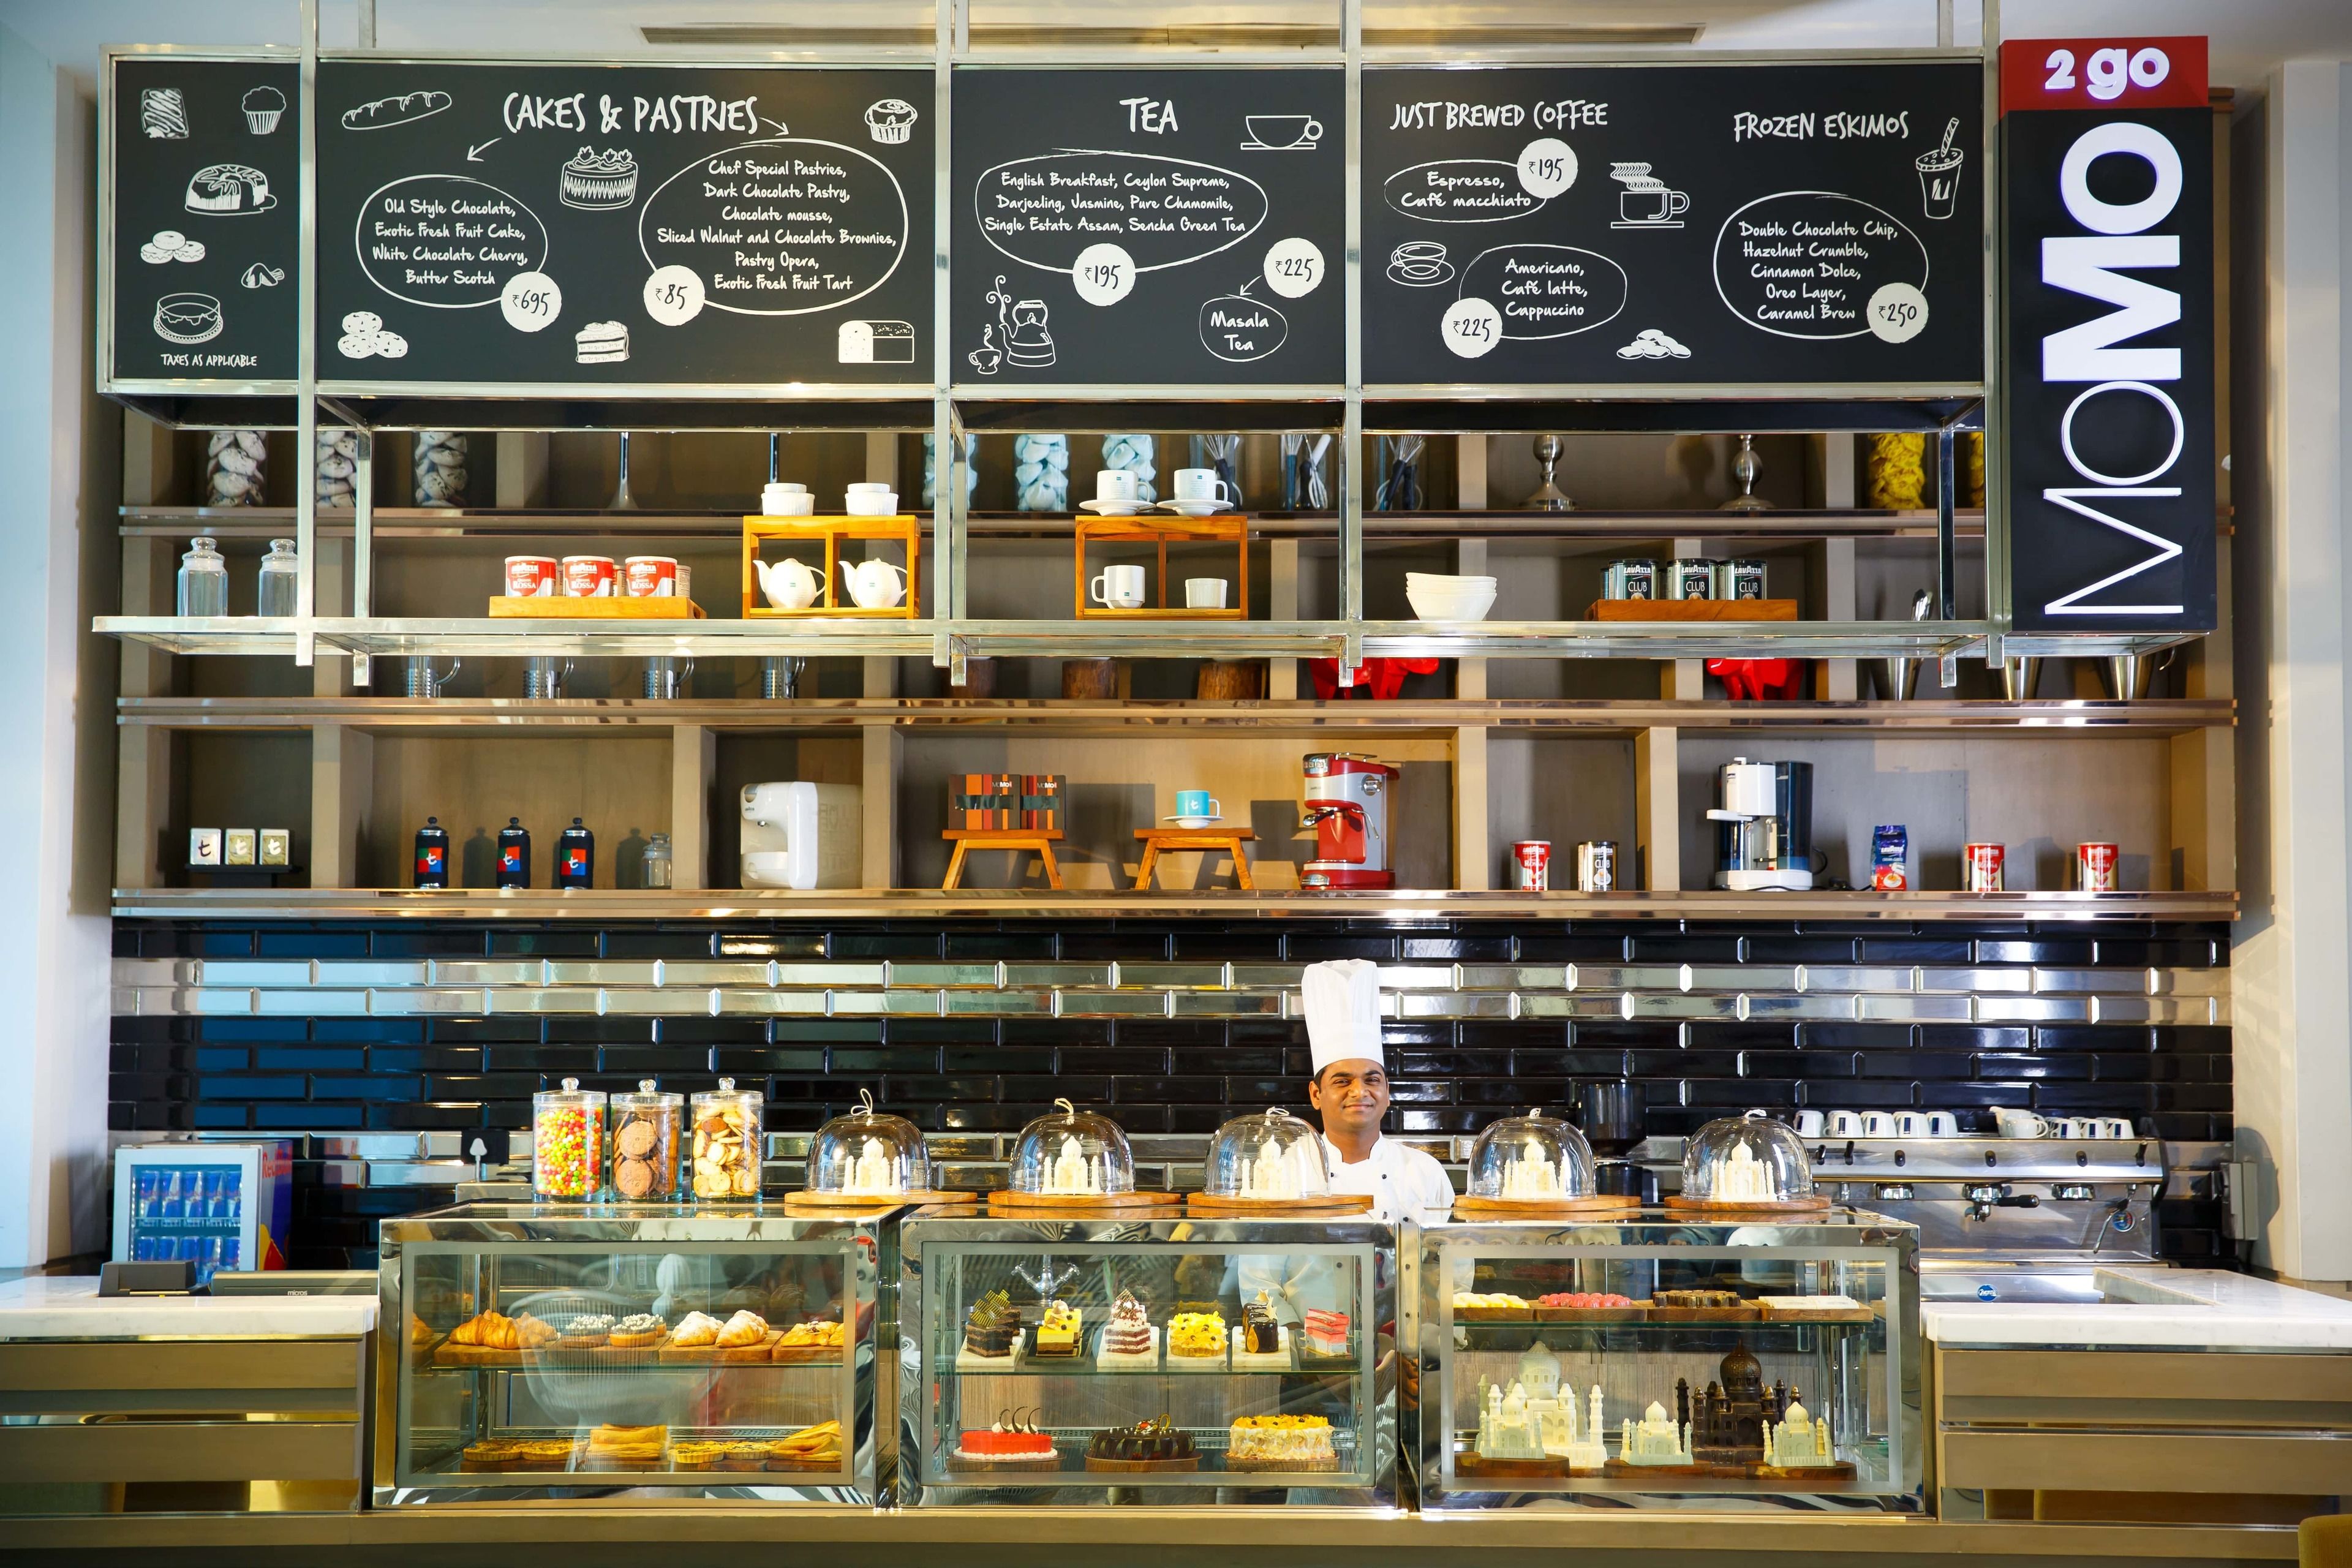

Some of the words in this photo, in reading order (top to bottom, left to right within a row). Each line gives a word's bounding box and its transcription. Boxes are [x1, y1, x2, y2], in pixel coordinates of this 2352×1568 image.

[2044, 49, 2075, 90] 2
[2085, 47, 2170, 100] go
[503, 92, 586, 133] CAKES
[600, 94, 622, 134] &
[634, 95, 758, 134] PASTRIES
[1119, 97, 1178, 134] TEA
[1390, 102, 1442, 130] JUST
[1446, 102, 1525, 130] BREWED
[1534, 100, 1608, 130] COFFEE
[1734, 112, 1815, 142] FROZEN
[1824, 111, 1908, 139] ESKIMOS
[709, 160, 741, 175] Chef
[745, 160, 788, 179] Special
[794, 160, 846, 178] Pastries,
[1529, 159, 1564, 181] ₹195
[1001, 172, 1044, 190] English
[1049, 172, 1118, 189] Breakfast,
[1124, 173, 1166, 191] Ceylon
[1172, 173, 1230, 189] Supreme,
[1427, 171, 1504, 191] Espresso,
[703, 182, 738, 197] Dark
[743, 183, 803, 198] Chocolate
[807, 183, 850, 203] Pastry,
[1401, 192, 1446, 206] Café
[1453, 192, 1532, 206] macchiato
[385, 198, 405, 213] Old
[410, 199, 447, 217] Style
[451, 199, 516, 217] Chocolate,
[996, 194, 1065, 213] Darjeeling,
[1071, 194, 1124, 211] Jasmine,
[1130, 195, 1159, 209] Pure
[1164, 195, 1233, 211] Chamomile,
[722, 206, 783, 221] Chocolate
[788, 212, 832, 224] mousse,
[375, 222, 414, 236] Exotic
[418, 222, 450, 237] Fresh
[456, 222, 483, 238] Fruit
[488, 223, 526, 241] Cake,
[985, 217, 1025, 235] Single
[1030, 217, 1072, 231] Estate
[1077, 217, 1123, 233] Assam,
[1129, 217, 1175, 231] Sencha
[1180, 216, 1217, 231] Green
[1221, 217, 1245, 231] Tea
[1739, 221, 1787, 236] Double
[1792, 221, 1858, 236] Chocolate
[1864, 221, 1898, 239] Chip,
[657, 228, 695, 243] Sliced
[701, 227, 743, 244] Walnut
[747, 229, 769, 243] and
[775, 229, 835, 244] Chocolate
[839, 228, 896, 247] Brownies,
[372, 245, 408, 260] White
[413, 246, 475, 261] Chocolate
[480, 247, 527, 266] Cherry,
[1743, 241, 1804, 257] Hazelnut
[1809, 242, 1868, 258] Crumble,
[735, 251, 774, 271] Pastry
[780, 251, 819, 271] Opera,
[1276, 259, 1314, 282] ₹225
[1505, 258, 1584, 276] Americano,
[1751, 263, 1814, 277] Cinnamon
[1819, 262, 1860, 279] Dolce,
[405, 269, 448, 284] Butter
[453, 270, 495, 284] Scotch
[714, 274, 753, 289] Exotic
[756, 274, 787, 289] Fresh
[793, 274, 820, 290] Fruit
[823, 274, 853, 290] Tart
[1085, 265, 1120, 289] ₹195
[657, 284, 687, 309] ₹85
[1502, 281, 1542, 295] Café
[1548, 281, 1588, 297] latte,
[1766, 284, 1796, 298] Oreo
[1803, 283, 1845, 302] Layer,
[513, 290, 550, 315] ₹695
[1506, 301, 1584, 321] Cappuccino
[1757, 305, 1814, 319] Caramel
[1820, 304, 1855, 318] Brew
[1211, 311, 1269, 327] Masala
[1879, 303, 1917, 327] ₹250
[1453, 318, 1491, 342] ₹225
[1224, 334, 1254, 350] Tea
[160, 353, 189, 366] TAXES
[192, 354, 203, 366] AS
[206, 355, 257, 368] APPLICABLE
[1623, 565, 1651, 574] LAVAZZA
[1681, 565, 1709, 574] LAVAZZA
[1628, 581, 1647, 592] CLUB
[1686, 581, 1705, 592] CLUB
[1740, 582, 1758, 592] CLUB
